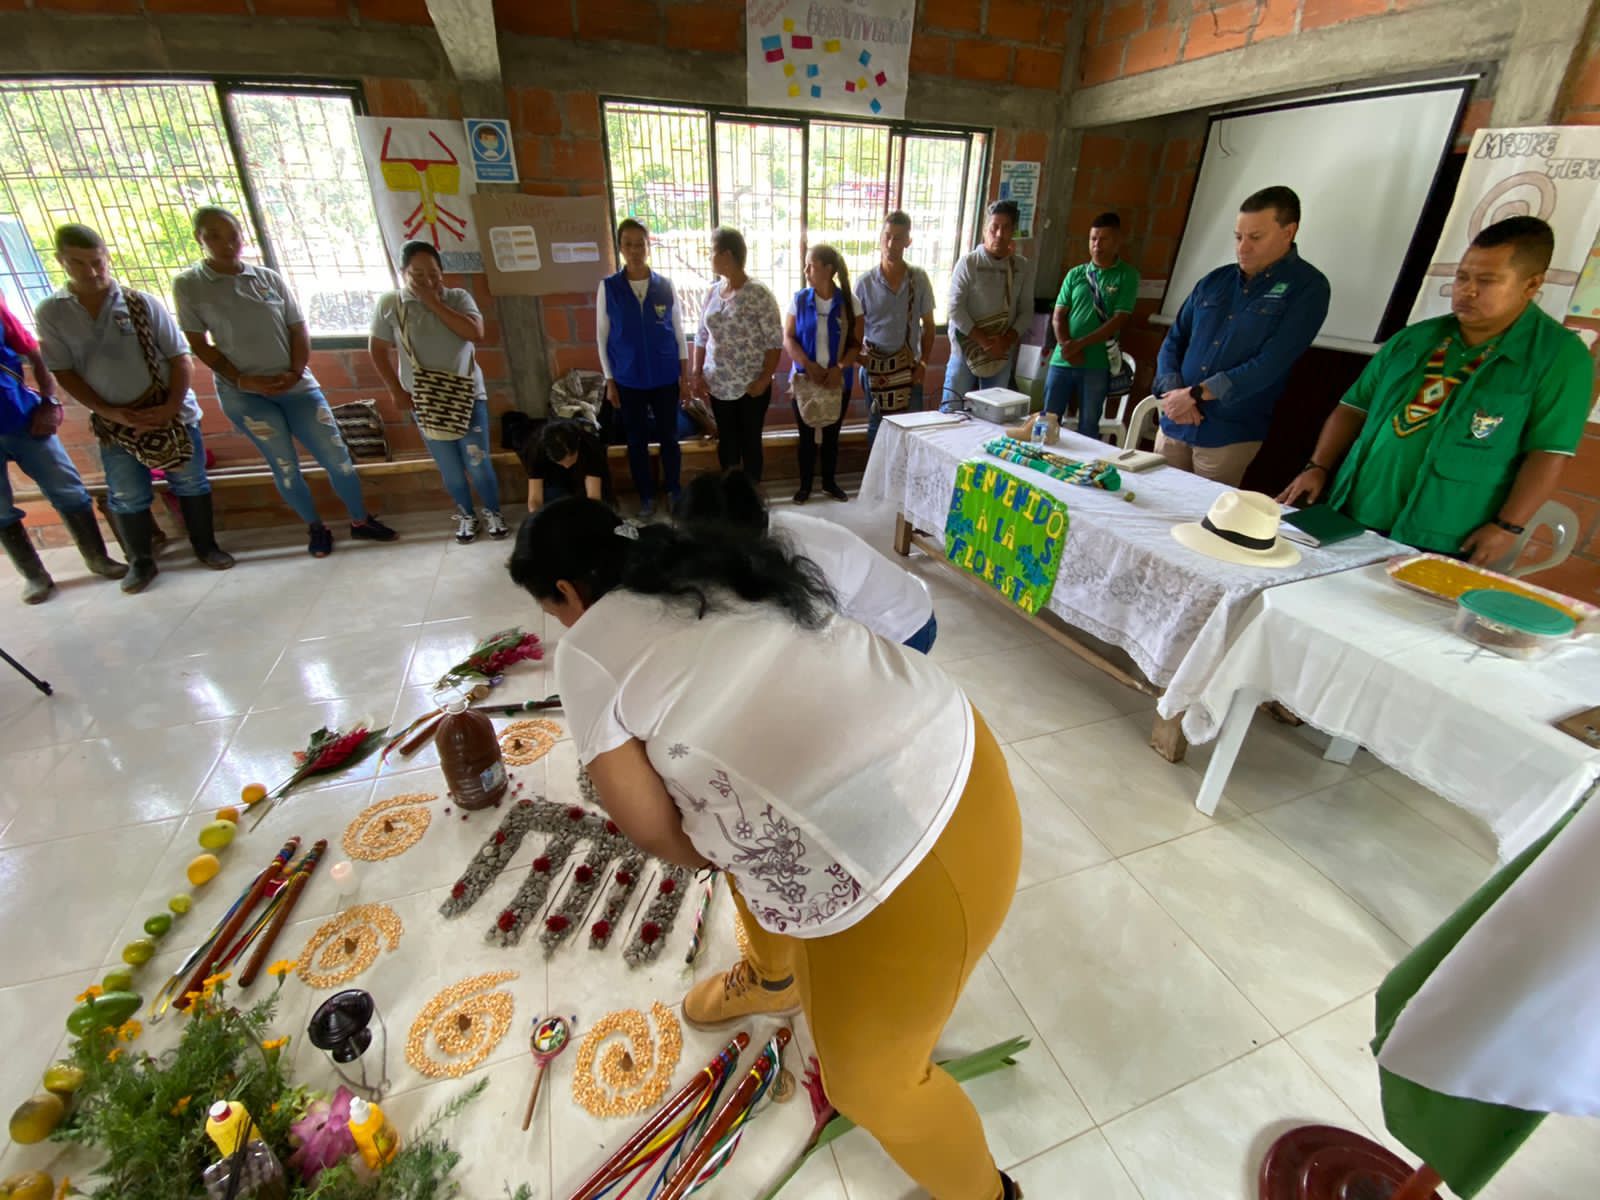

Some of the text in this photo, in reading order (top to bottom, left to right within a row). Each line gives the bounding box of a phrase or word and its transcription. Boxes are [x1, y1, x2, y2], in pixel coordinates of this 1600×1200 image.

[1473, 132, 1560, 159] MADRE
[950, 463, 1064, 565] BIENVENIDOS
[976, 508, 1015, 550] A LA
[949, 537, 1033, 613] FLORESTA
